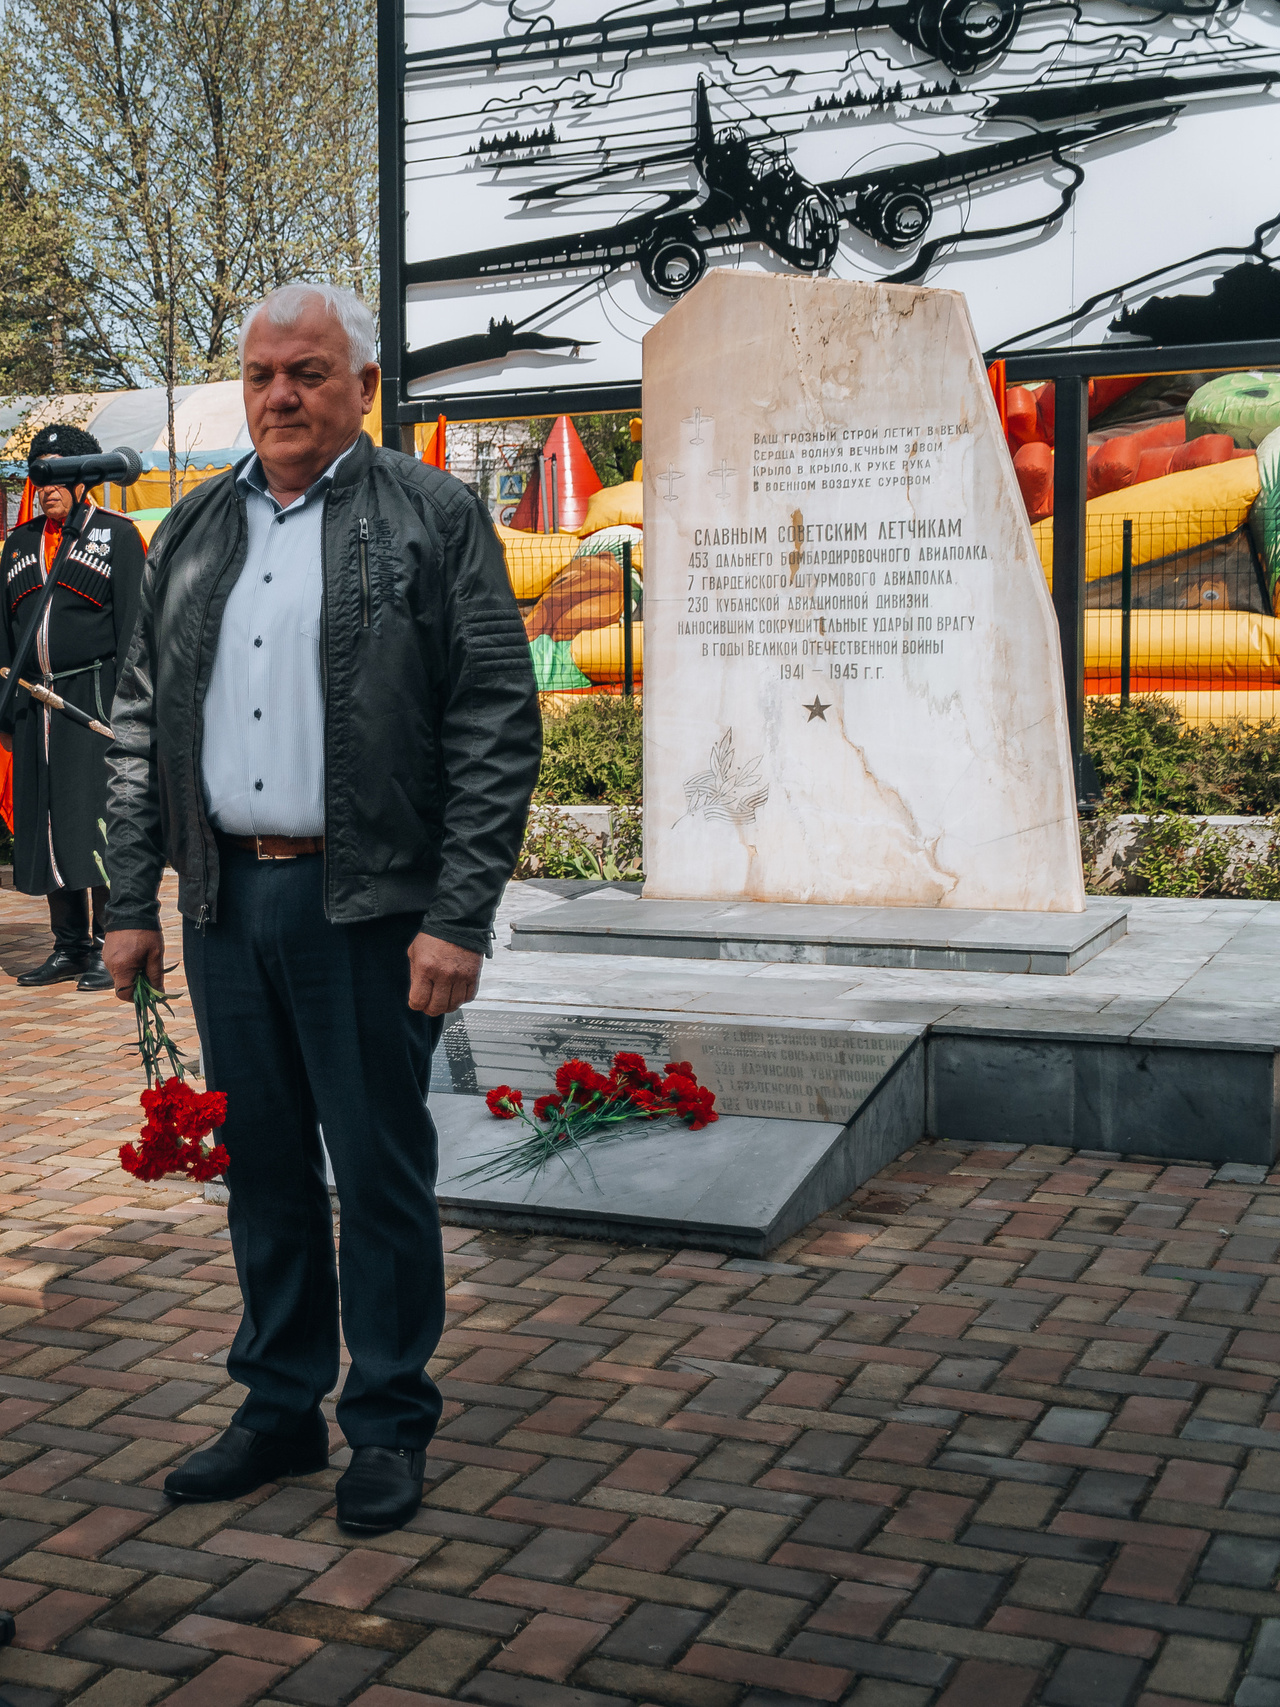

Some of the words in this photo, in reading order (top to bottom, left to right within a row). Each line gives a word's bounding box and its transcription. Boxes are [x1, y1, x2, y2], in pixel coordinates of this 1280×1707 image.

[784, 429, 837, 443] ГРОЗНЫЙ
[842, 425, 878, 440] СТРОЙ
[884, 426, 920, 439] ЛЕТИТ
[927, 426, 934, 436] В
[940, 424, 970, 436] ВЕКА
[801, 447, 843, 459] ВОЛНУЯ
[849, 444, 898, 457] ВЕЧНЫМ
[797, 465, 804, 475] В
[867, 460, 896, 472] РУКЕ
[902, 459, 932, 470] РУКА
[765, 480, 816, 492] ВОЕННОМ
[821, 477, 872, 490] ВОЗДУХЕ
[694, 527, 768, 546] СЛАВНЫМ
[777, 521, 868, 542] СОВЕТСКИМ
[878, 518, 962, 540] ЛЕТЧИКАМ
[687, 551, 709, 568] 453
[715, 552, 773, 568] ДАЛЬНЕГО
[780, 547, 910, 567] БОМБАРДИРОВОЧНОГО
[687, 574, 695, 591] 7
[795, 571, 876, 588] ШТУРМОВОГО
[687, 596, 709, 613] 230
[716, 594, 780, 613] КУБАНСКОЙ
[787, 591, 868, 611] АВИАЦИОННОЙ
[677, 620, 754, 636] НАНОСИВШИМ
[759, 617, 868, 635] СОКРУШИТЕЛЬНЫЕ
[872, 616, 913, 632] УДАРЫ
[917, 616, 932, 632] ПО
[937, 615, 975, 632] ВРАГУ
[702, 642, 709, 657] В
[713, 642, 744, 656] ГОДЫ
[902, 636, 944, 654] ВОЙНЫ
[780, 664, 804, 680] 1941
[830, 663, 858, 680] 1945
